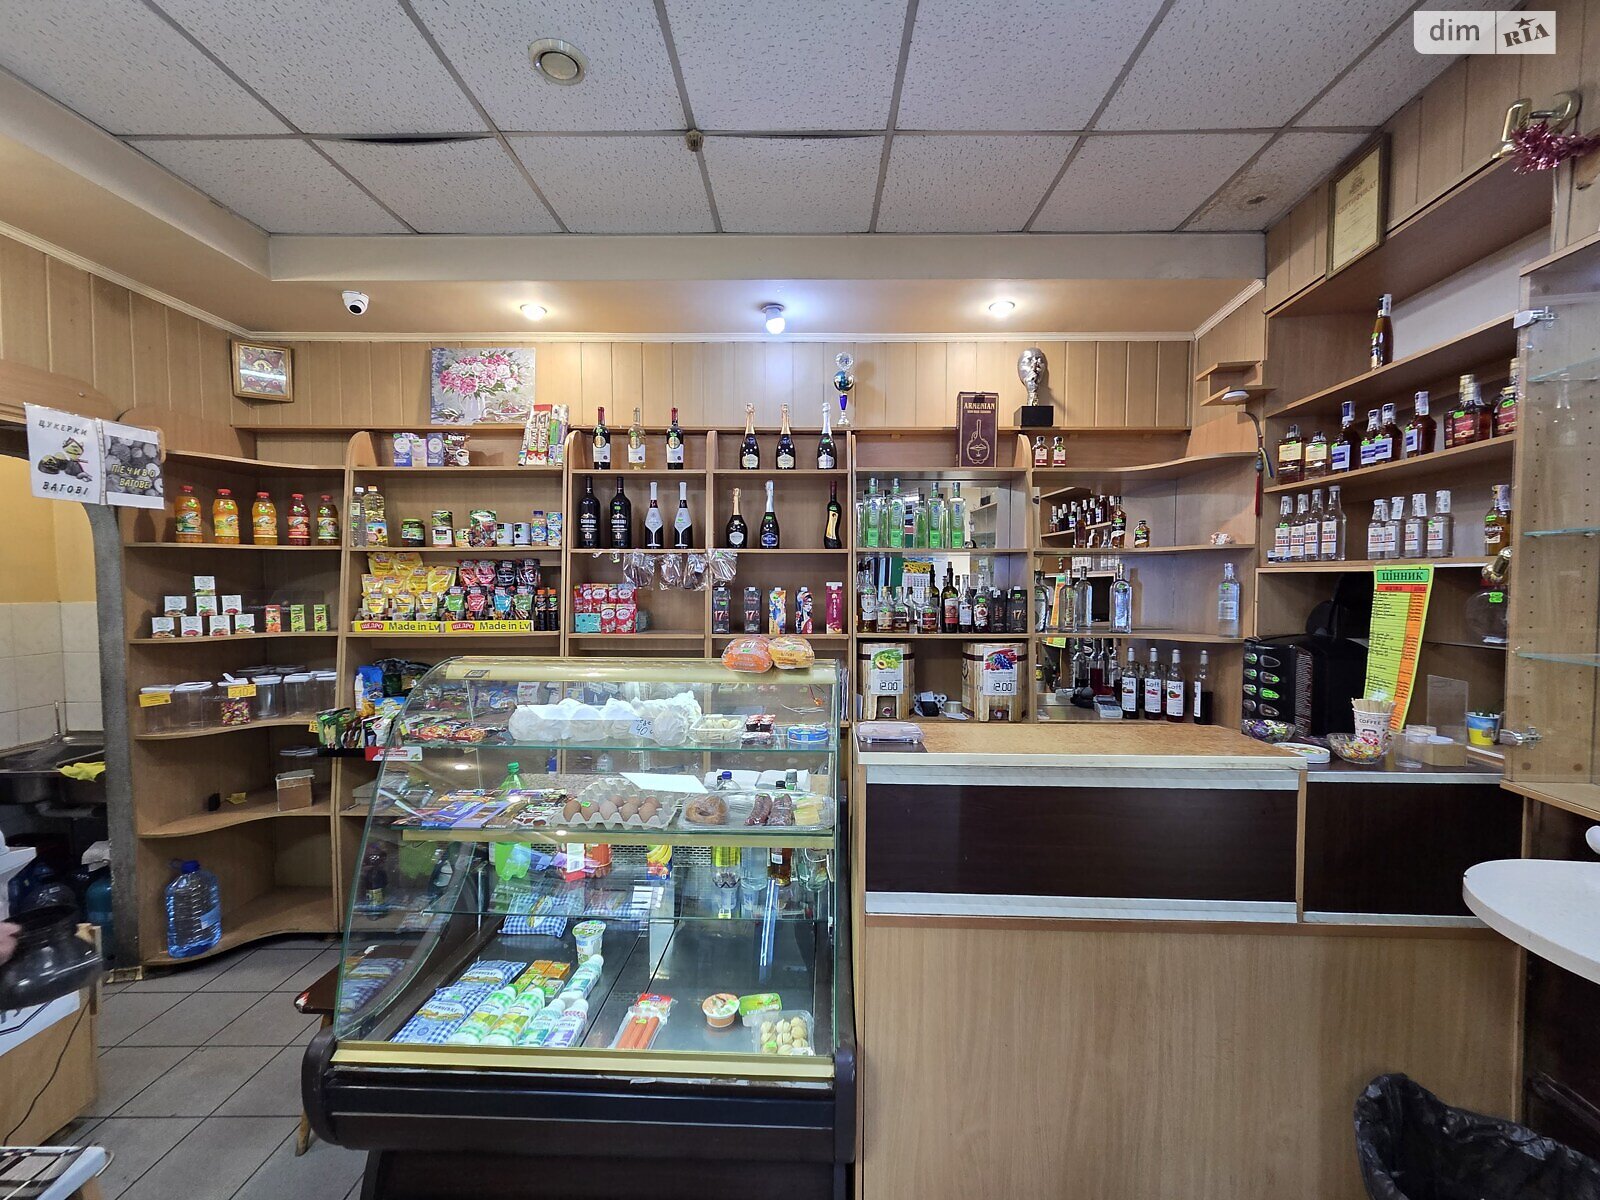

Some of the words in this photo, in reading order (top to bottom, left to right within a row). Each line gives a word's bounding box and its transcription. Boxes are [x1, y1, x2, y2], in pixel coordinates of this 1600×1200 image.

[963, 402, 996, 410] ARMENIAN
[38, 420, 87, 436] ЦУКЕРКИ
[111, 464, 156, 478] ПЕЧИВО
[42, 481, 89, 495] ВАГОВІ
[119, 478, 152, 489] ВАГОВЕ
[388, 622, 415, 631] Made
[417, 622, 427, 631] in
[479, 621, 506, 630] Made
[508, 621, 517, 630] in
[1359, 718, 1382, 726] COFFEE
